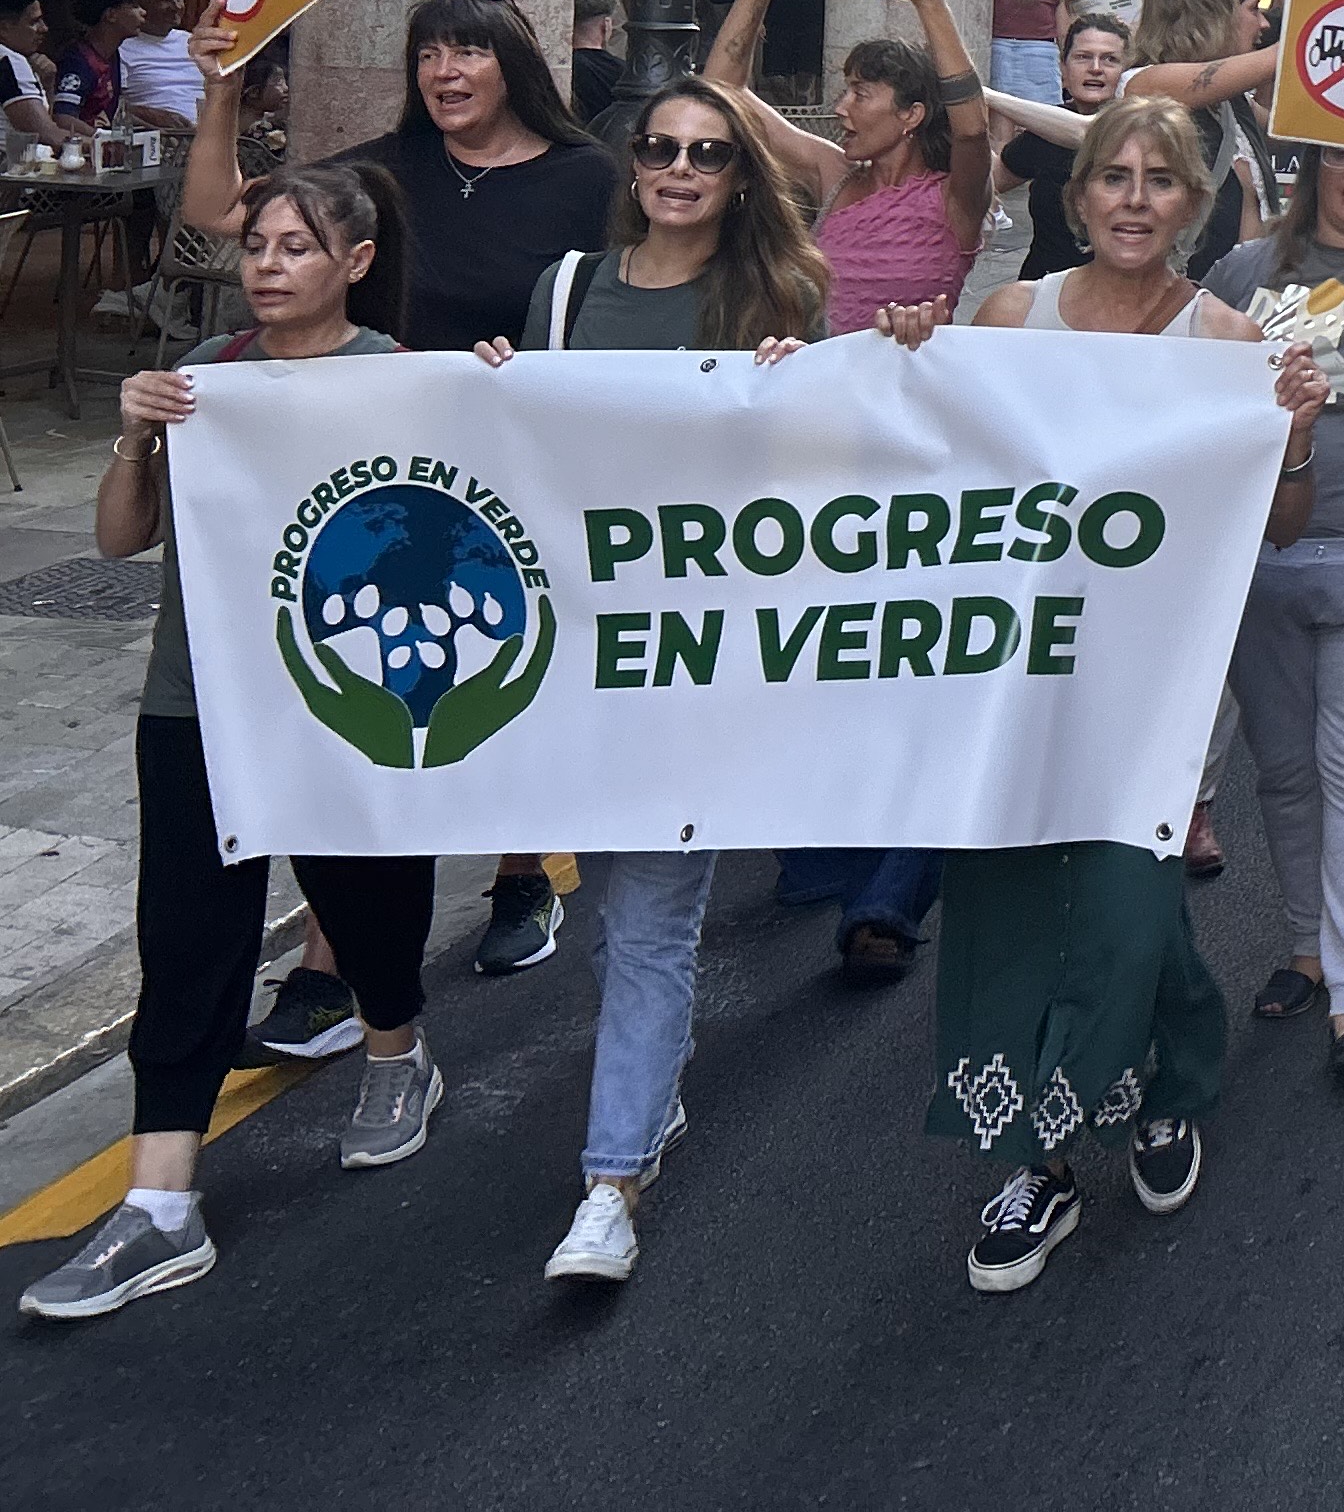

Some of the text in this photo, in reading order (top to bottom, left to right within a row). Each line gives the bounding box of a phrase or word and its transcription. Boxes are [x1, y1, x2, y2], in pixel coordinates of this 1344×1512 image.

[271, 455, 552, 603] PROGRESO EN VERDE
[583, 481, 1166, 583] PROGRESO
[594, 594, 1086, 690] EN VERDE
